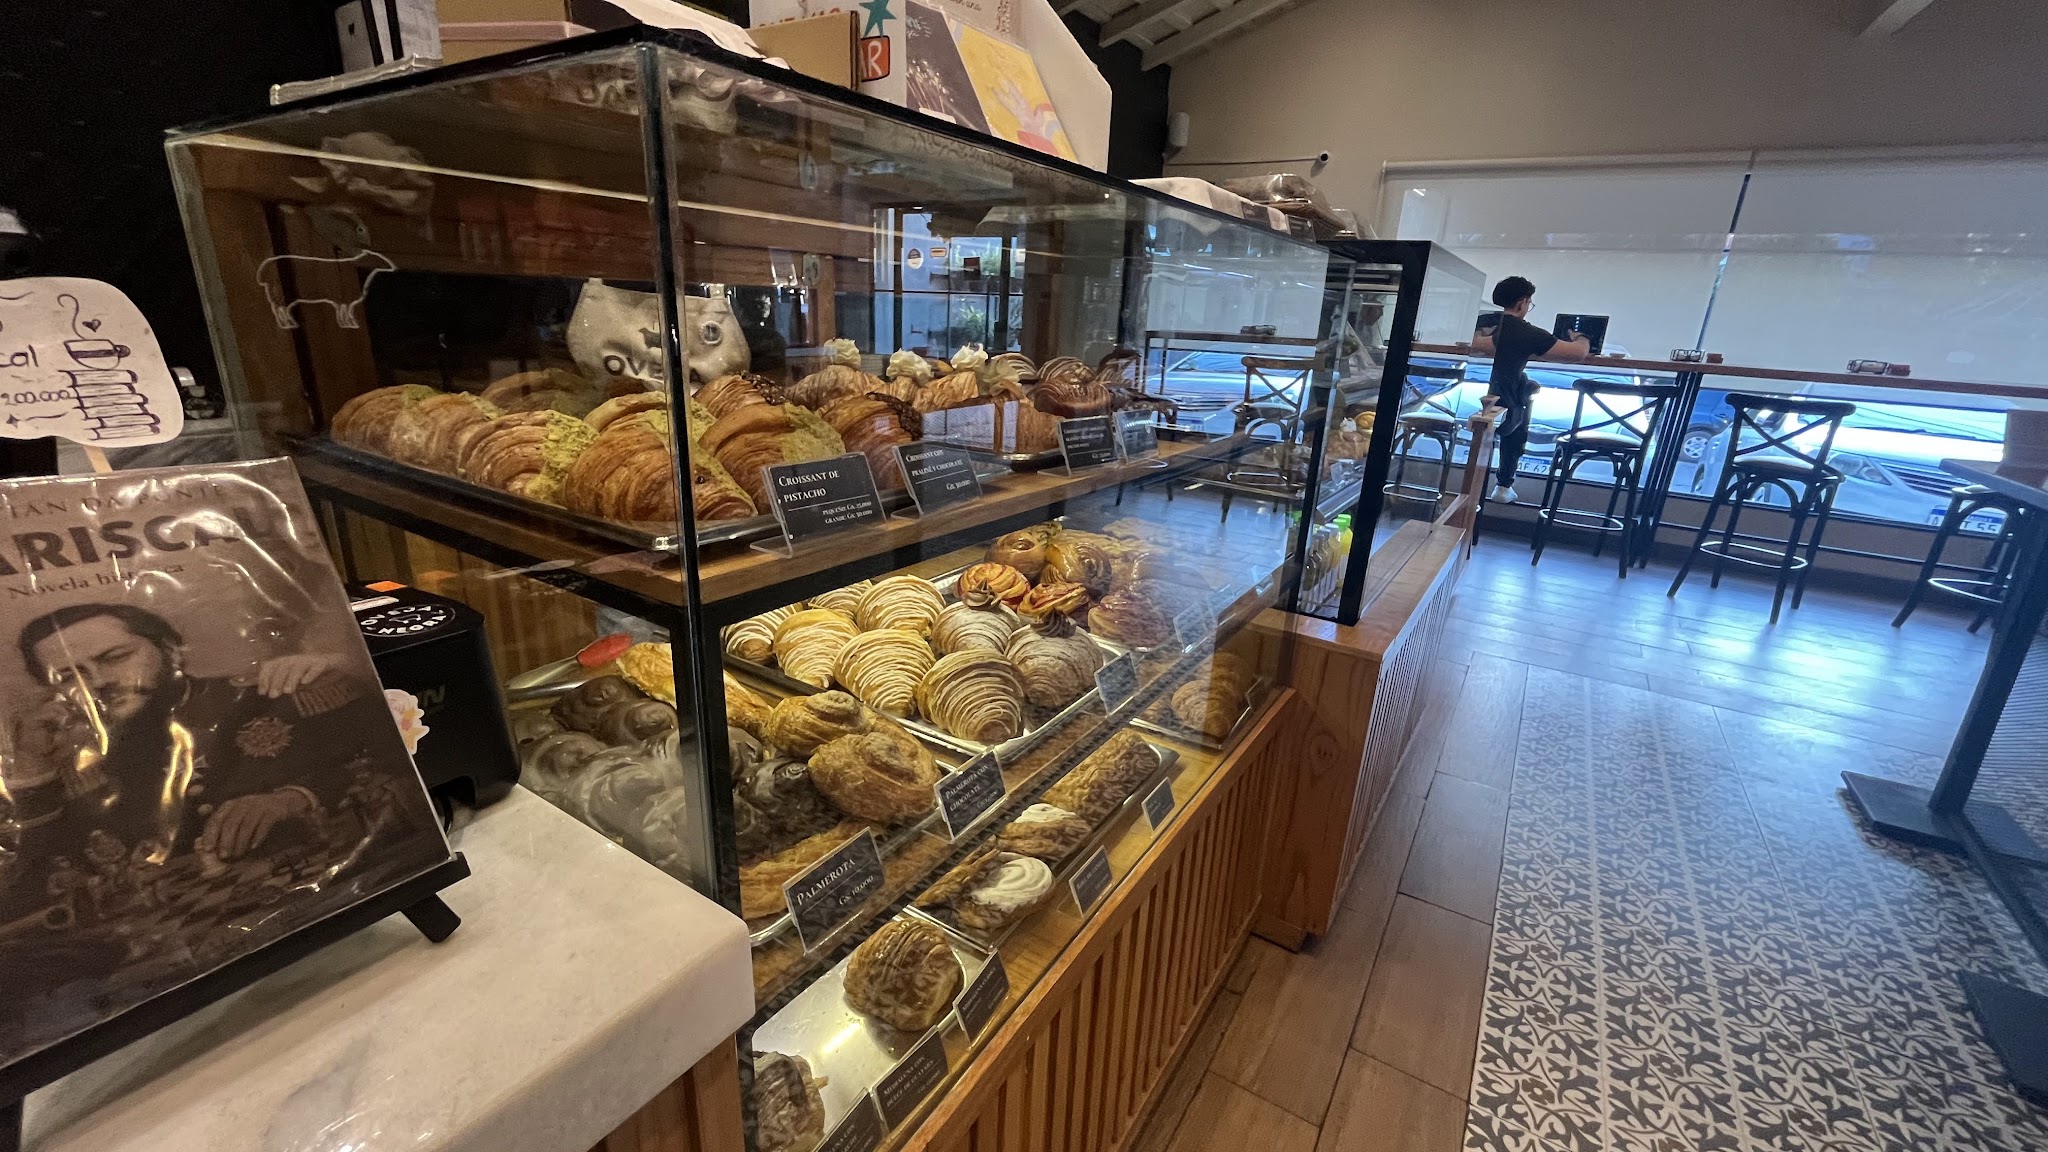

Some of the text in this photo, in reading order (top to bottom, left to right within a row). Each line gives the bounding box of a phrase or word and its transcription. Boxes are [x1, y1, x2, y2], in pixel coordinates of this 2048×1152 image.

[778, 470, 841, 487] CROISSANT DE
[783, 487, 828, 503] PISTACHO
[8, 575, 90, 600] Novela
[378, 615, 447, 635] NEGRA
[795, 858, 856, 906] PALMEROTA
